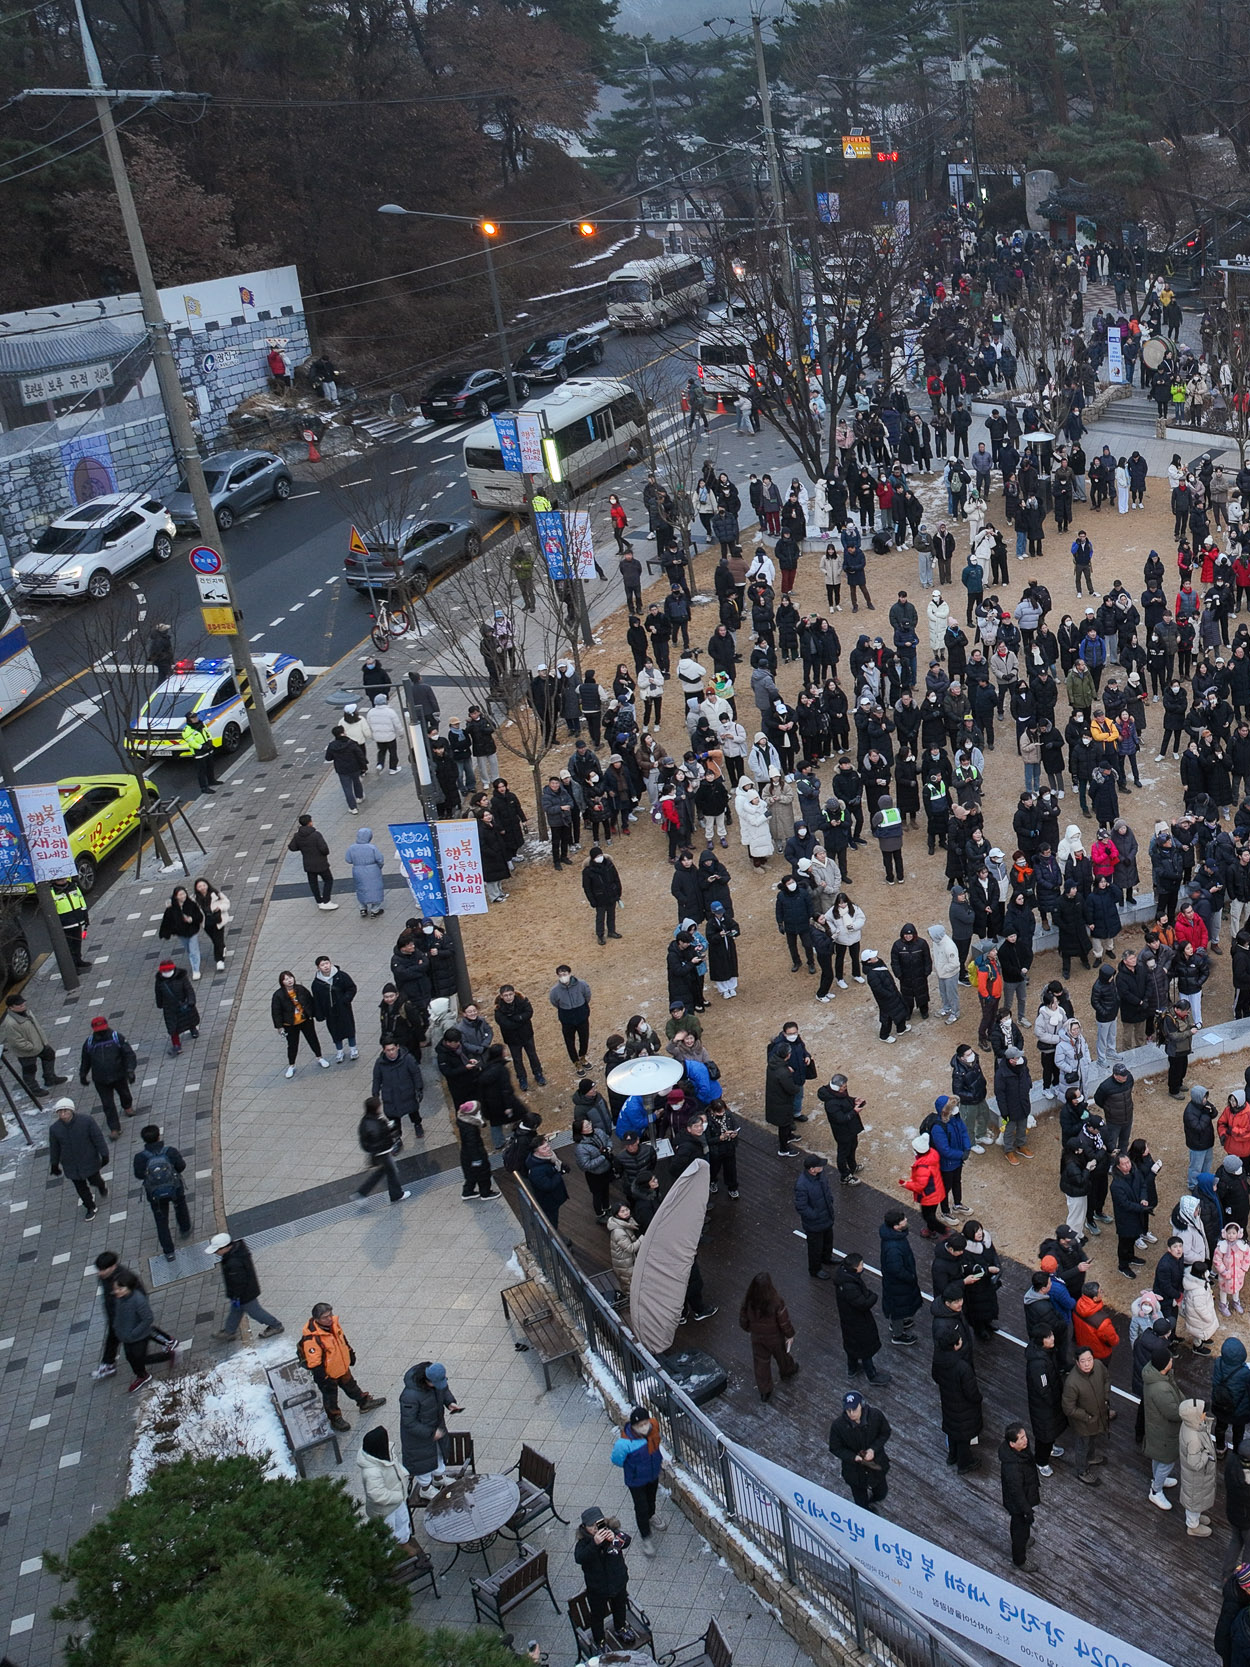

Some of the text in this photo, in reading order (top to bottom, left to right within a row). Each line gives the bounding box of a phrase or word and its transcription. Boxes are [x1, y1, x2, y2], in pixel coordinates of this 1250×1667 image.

[47, 377, 64, 393] 보루
[69, 371, 88, 389] 유적
[521, 447, 541, 456] 새해
[27, 804, 56, 826] 행복
[32, 824, 62, 838] 가득한
[90, 822, 102, 842] 119
[393, 831, 430, 844] 2024
[32, 837, 68, 850] 새해
[444, 838, 473, 861] 행복
[36, 850, 70, 860] 되세요
[447, 860, 478, 871] 가득한
[446, 872, 483, 885] 새해
[450, 886, 483, 895] 되세요
